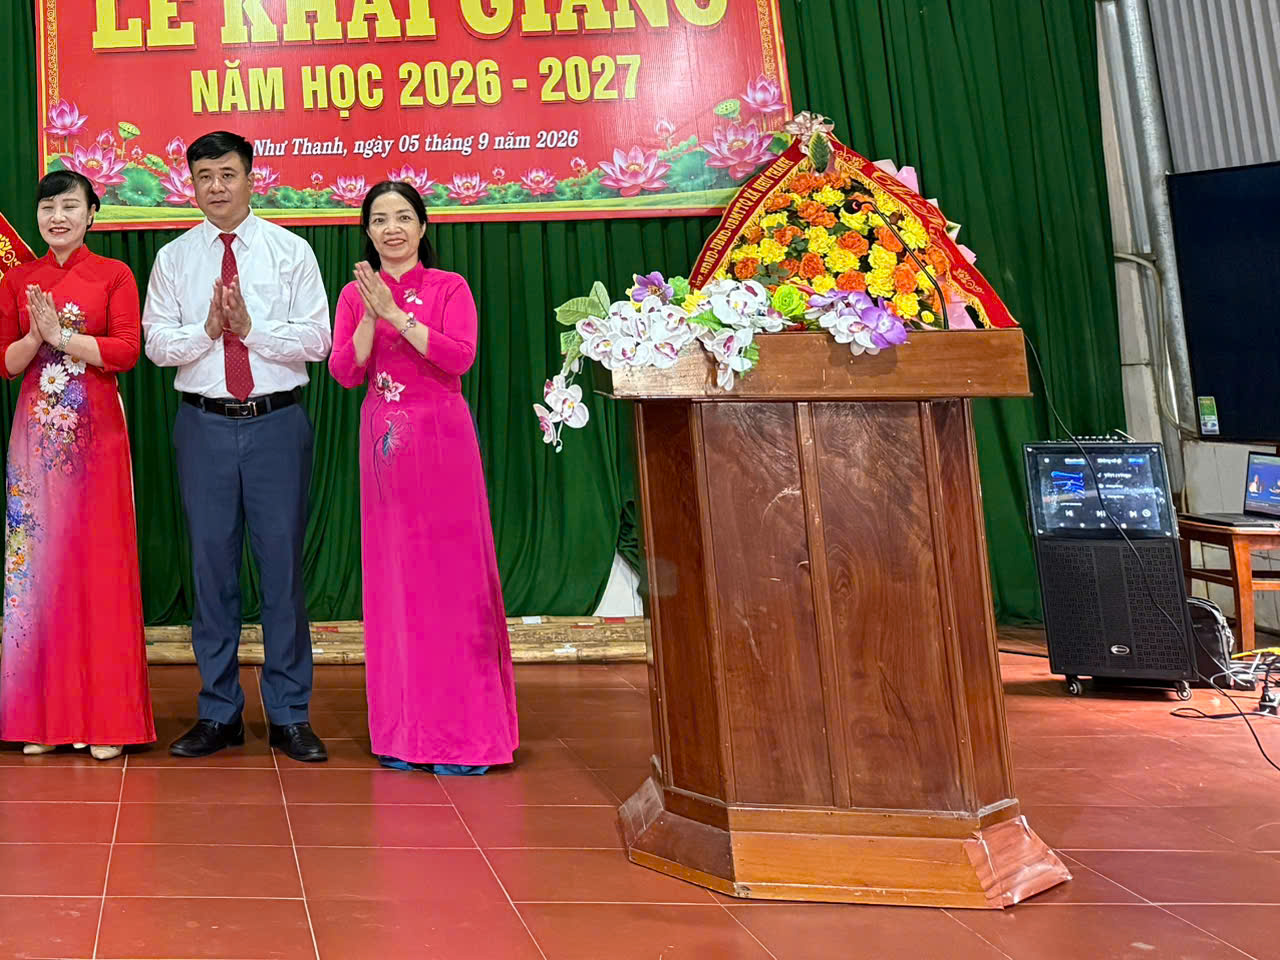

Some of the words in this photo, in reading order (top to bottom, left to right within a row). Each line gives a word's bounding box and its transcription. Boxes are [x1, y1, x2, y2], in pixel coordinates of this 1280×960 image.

[190, 59, 285, 113] NĂM
[305, 62, 384, 120] HỌC
[399, 58, 502, 106] 2026
[512, 79, 527, 90] -
[540, 54, 641, 102] 2027
[253, 138, 287, 157] Như
[291, 137, 348, 158] Thanh,
[353, 134, 393, 158] ngày
[398, 134, 420, 152] 05
[424, 133, 475, 155] tháng
[478, 132, 489, 150] 9
[493, 130, 531, 150] năm
[536, 129, 580, 149] 2026
